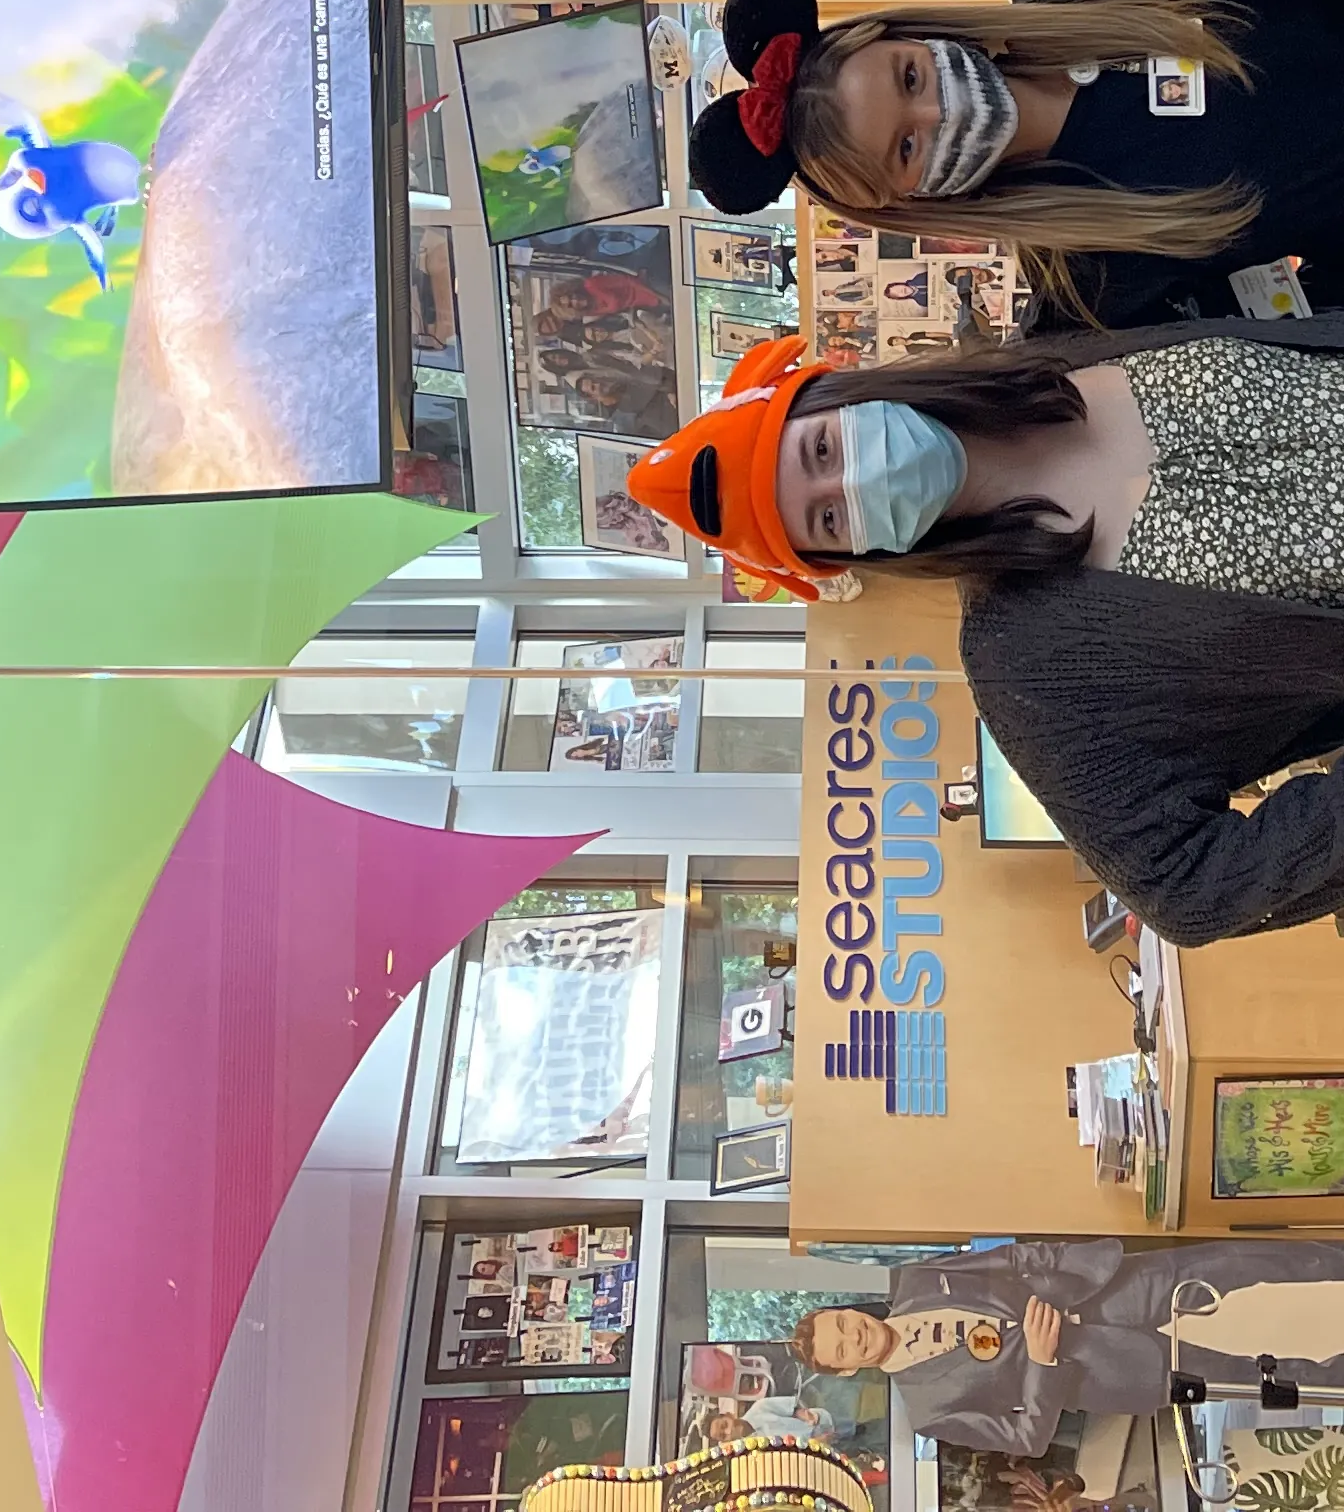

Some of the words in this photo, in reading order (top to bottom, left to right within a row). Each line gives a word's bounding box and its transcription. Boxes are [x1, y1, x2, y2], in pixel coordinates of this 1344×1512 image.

[316, 35, 328, 60] una
[317, 63, 329, 80] es
[663, 60, 679, 79] M
[314, 83, 332, 120] ¿Qué
[317, 124, 331, 179] Gracias.
[879, 655, 945, 1007] STUDIOS
[740, 1008, 763, 1033] G
[1303, 1103, 1333, 1137] Mine
